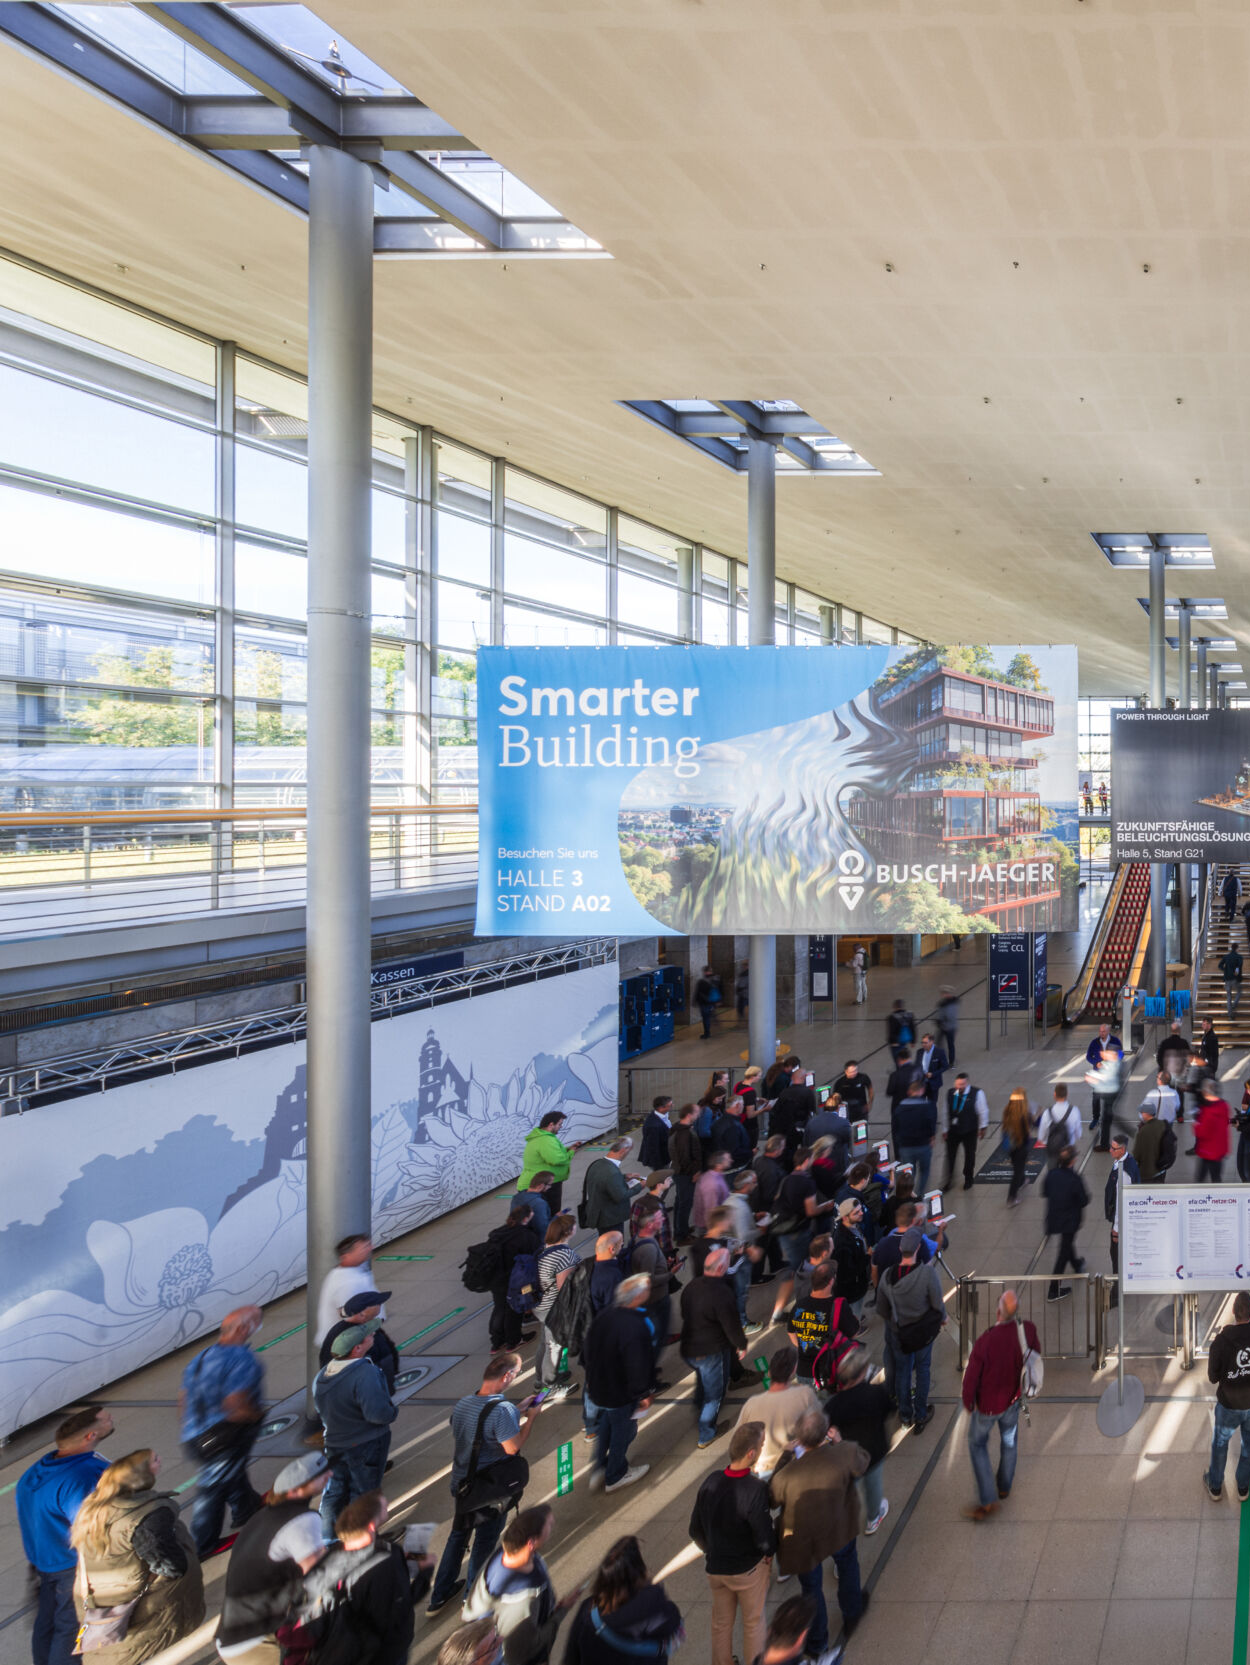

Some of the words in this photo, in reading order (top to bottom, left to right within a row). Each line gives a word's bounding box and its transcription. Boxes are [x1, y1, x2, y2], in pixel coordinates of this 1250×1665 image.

[499, 675, 699, 716] Smarter
[498, 723, 701, 778] Building
[1116, 820, 1215, 832] ZUKUNFTSFÄHIGE
[498, 847, 554, 859] Besuchen
[557, 847, 575, 859] Sie
[577, 849, 599, 859] uns
[1116, 849, 1140, 858] Halle
[1142, 849, 1152, 859] 5,
[1154, 849, 1182, 858] Stand
[1184, 849, 1205, 858] G21
[497, 869, 565, 887] HALLE
[571, 869, 583, 887] 3
[876, 863, 1055, 884] BUSCH-JAEGER
[497, 894, 566, 912] STAND
[571, 894, 611, 912] A02
[1010, 944, 1025, 952] CCL
[370, 967, 415, 985] Kassen
